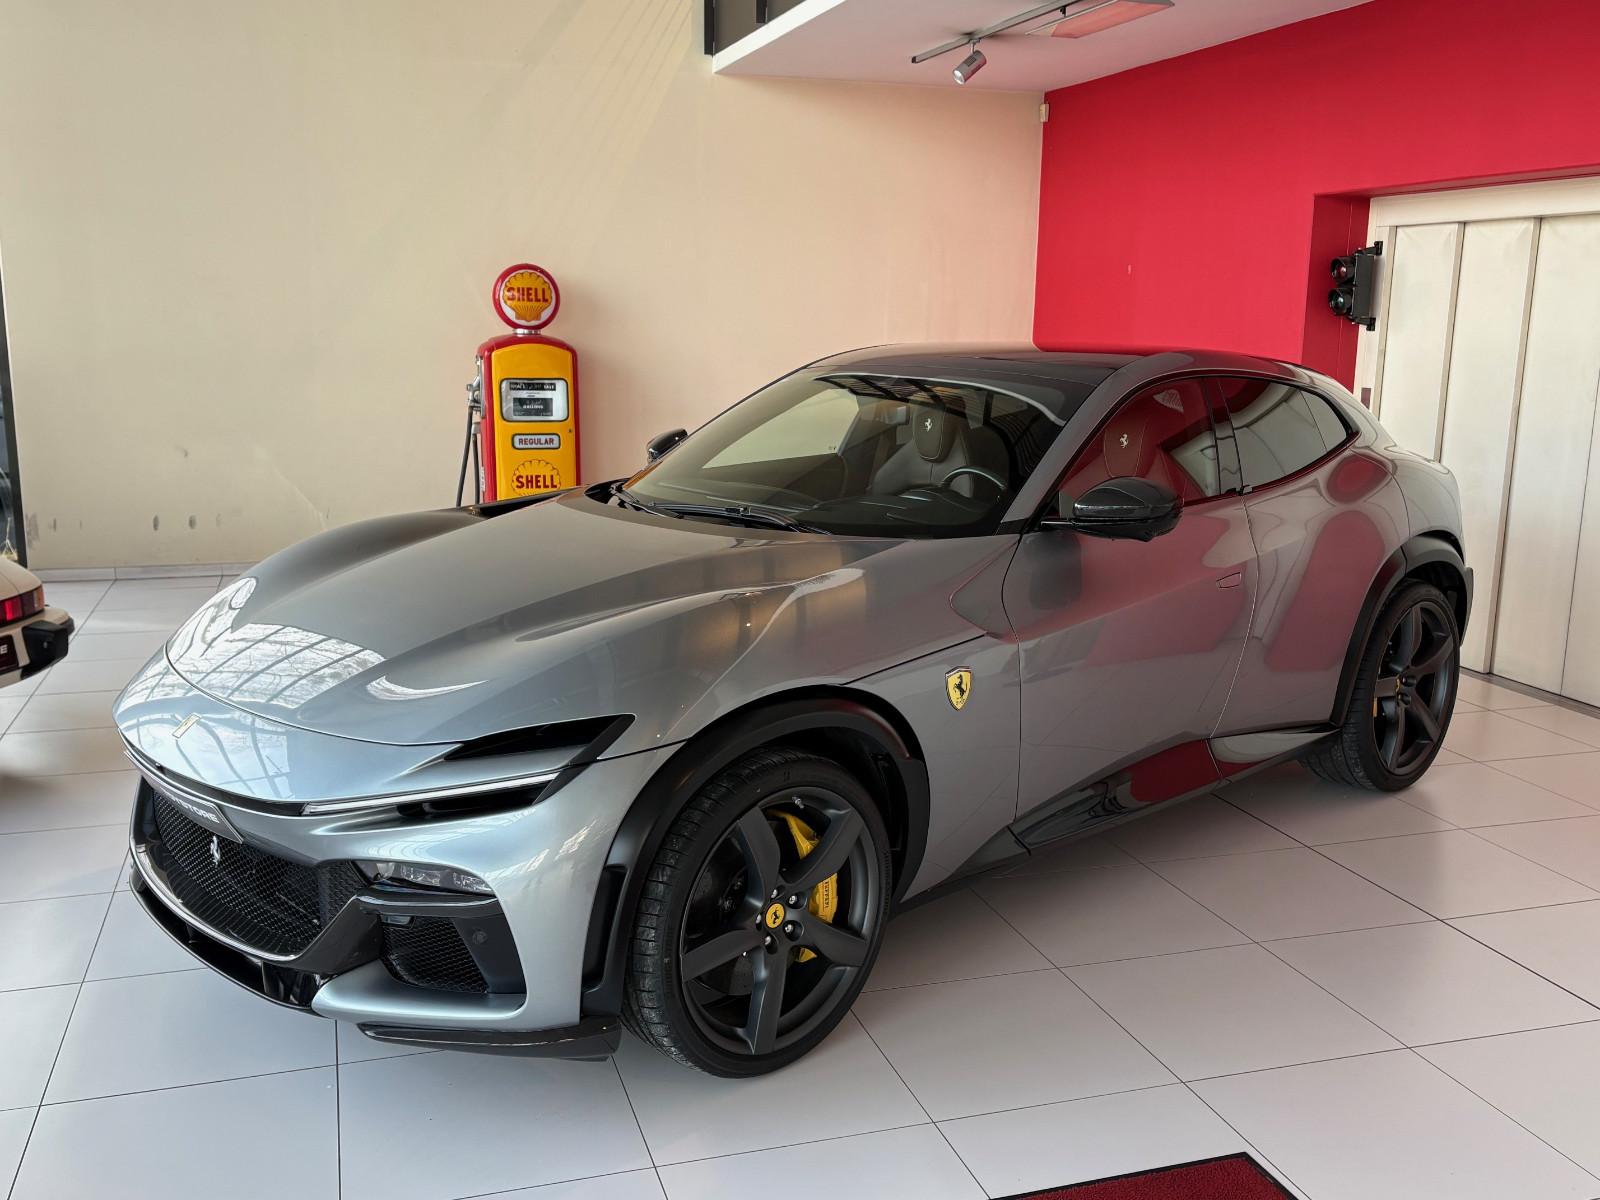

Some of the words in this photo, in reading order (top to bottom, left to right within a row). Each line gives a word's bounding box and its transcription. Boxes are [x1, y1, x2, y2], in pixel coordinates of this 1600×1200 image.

[506, 286, 549, 303] SHELL
[518, 437, 555, 446] REGULAR
[515, 474, 558, 489] SHELL
